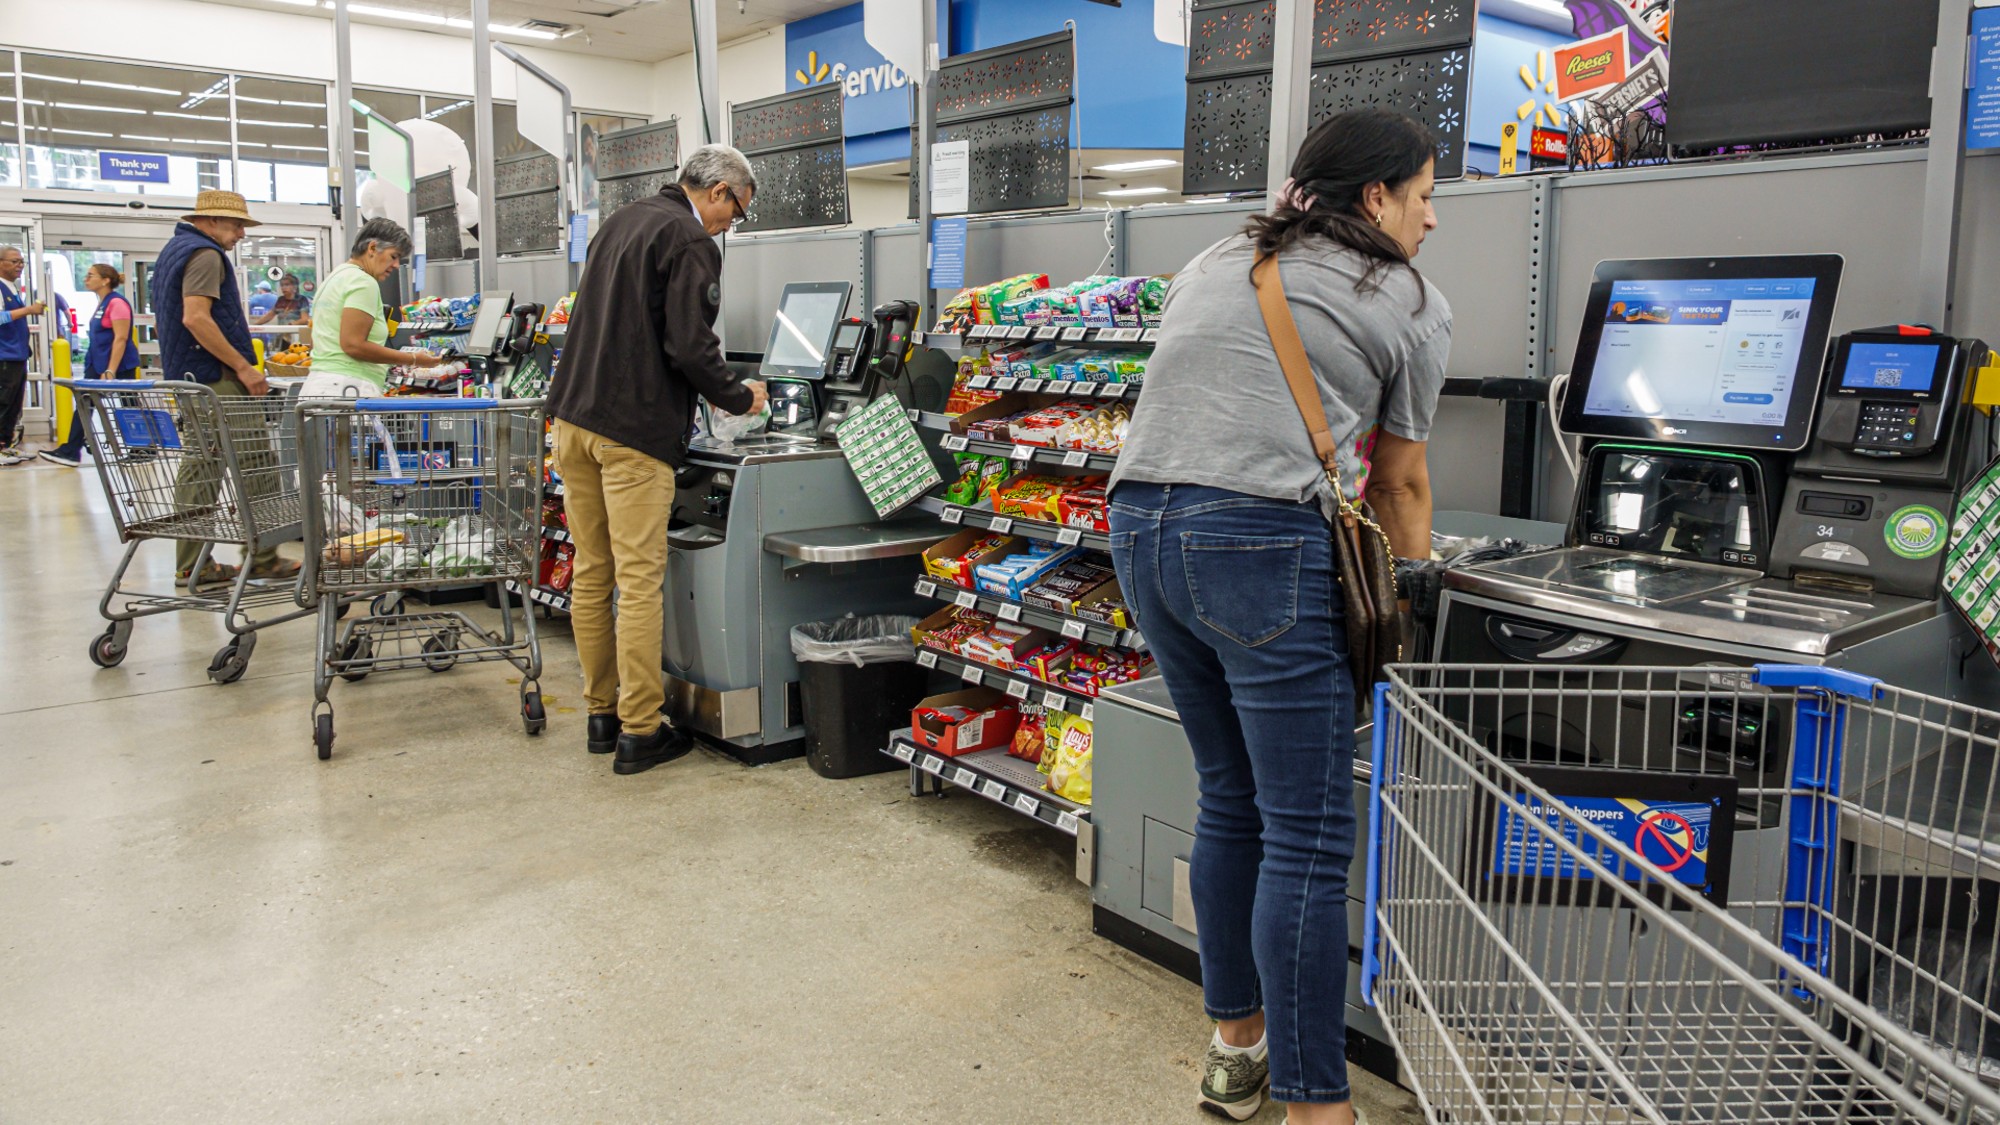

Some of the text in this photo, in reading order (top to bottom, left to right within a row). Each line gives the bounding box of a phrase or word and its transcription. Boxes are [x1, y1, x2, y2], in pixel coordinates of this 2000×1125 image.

[1566, 51, 1614, 76] Reese's
[832, 62, 914, 98] Servic
[1546, 138, 1568, 153] Rollba
[109, 158, 159, 171] Thank you
[1053, 315, 1078, 323] mentos
[1013, 369, 1031, 379] Extra
[1085, 372, 1109, 382] Extra
[1817, 525, 1834, 537] 34
[1721, 677, 1753, 690] Cas Out
[1065, 727, 1091, 752] Lay's
[1564, 805, 1624, 820] hoppers
